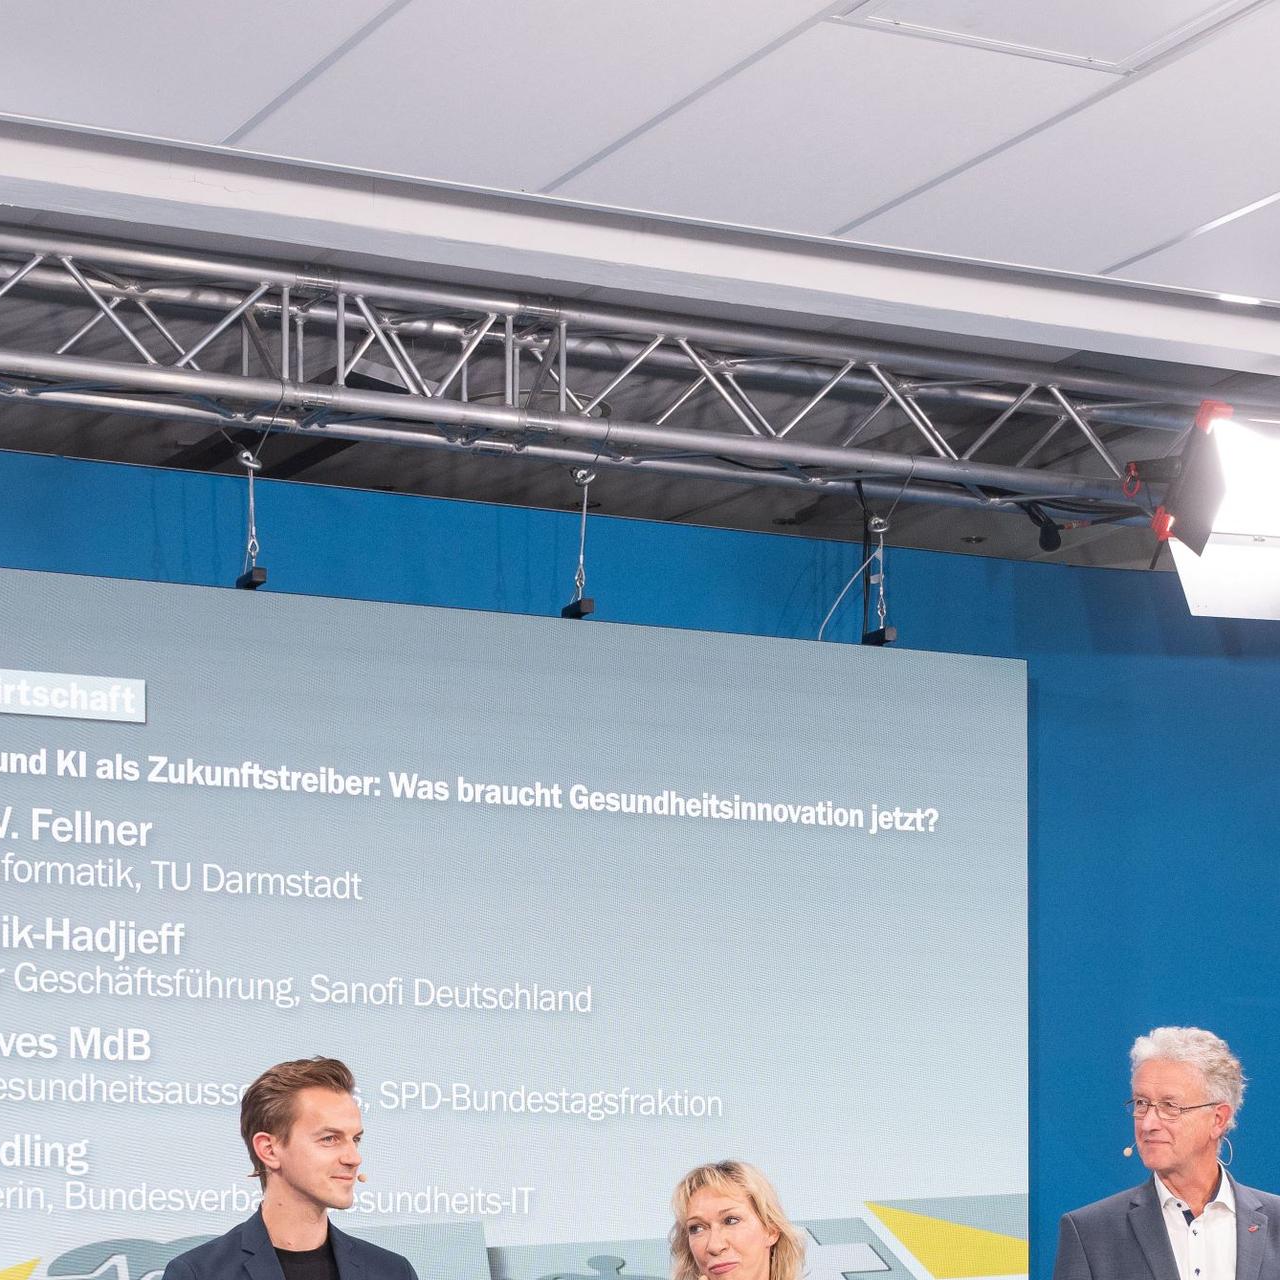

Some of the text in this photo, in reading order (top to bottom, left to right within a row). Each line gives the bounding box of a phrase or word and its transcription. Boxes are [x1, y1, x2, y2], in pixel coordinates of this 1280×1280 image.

[56, 750, 88, 782] KI
[95, 752, 141, 785] als
[146, 755, 383, 798] Zukunftstreiber:
[389, 770, 450, 802] Was
[457, 776, 563, 810] braucht
[569, 784, 864, 830] Gesundheitsinnovation
[868, 803, 940, 835] jetzt?
[31, 806, 153, 848] Fellner
[150, 860, 194, 892] TU
[202, 862, 364, 901] Darmstadt
[13, 961, 301, 1010] Geschäftsführung,
[309, 973, 405, 1006] Sanofi
[413, 977, 593, 1013] Deutschland
[69, 1027, 152, 1062] MdB
[378, 1080, 724, 1123] SPD-Bundestagsfraktion
[64, 1181, 265, 1213] Bundesverba
[350, 1185, 536, 1217] sundheits-IT
